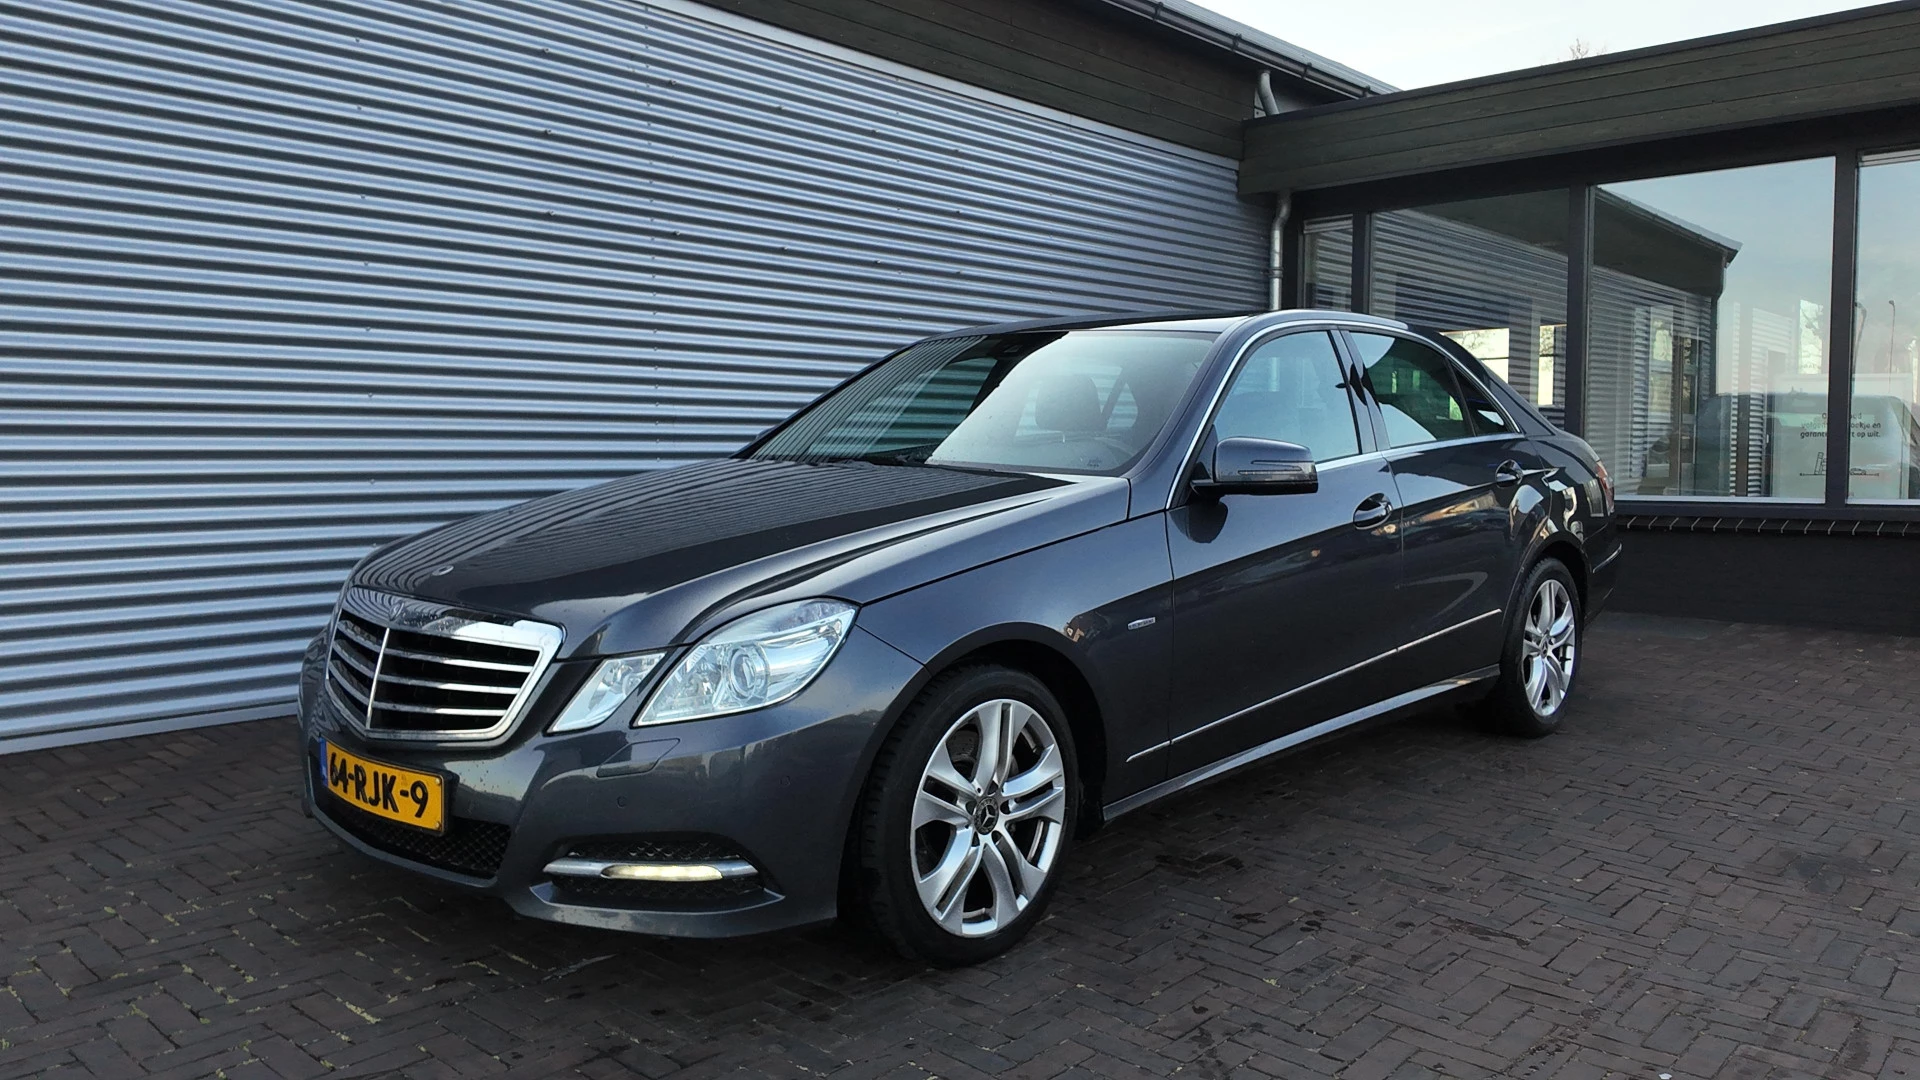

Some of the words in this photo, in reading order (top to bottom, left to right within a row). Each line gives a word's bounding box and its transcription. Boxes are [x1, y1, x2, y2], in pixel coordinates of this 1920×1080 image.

[1850, 421, 1870, 430] oekje
[1857, 431, 1866, 439] op
[330, 752, 429, 818] 64-RJK-9
